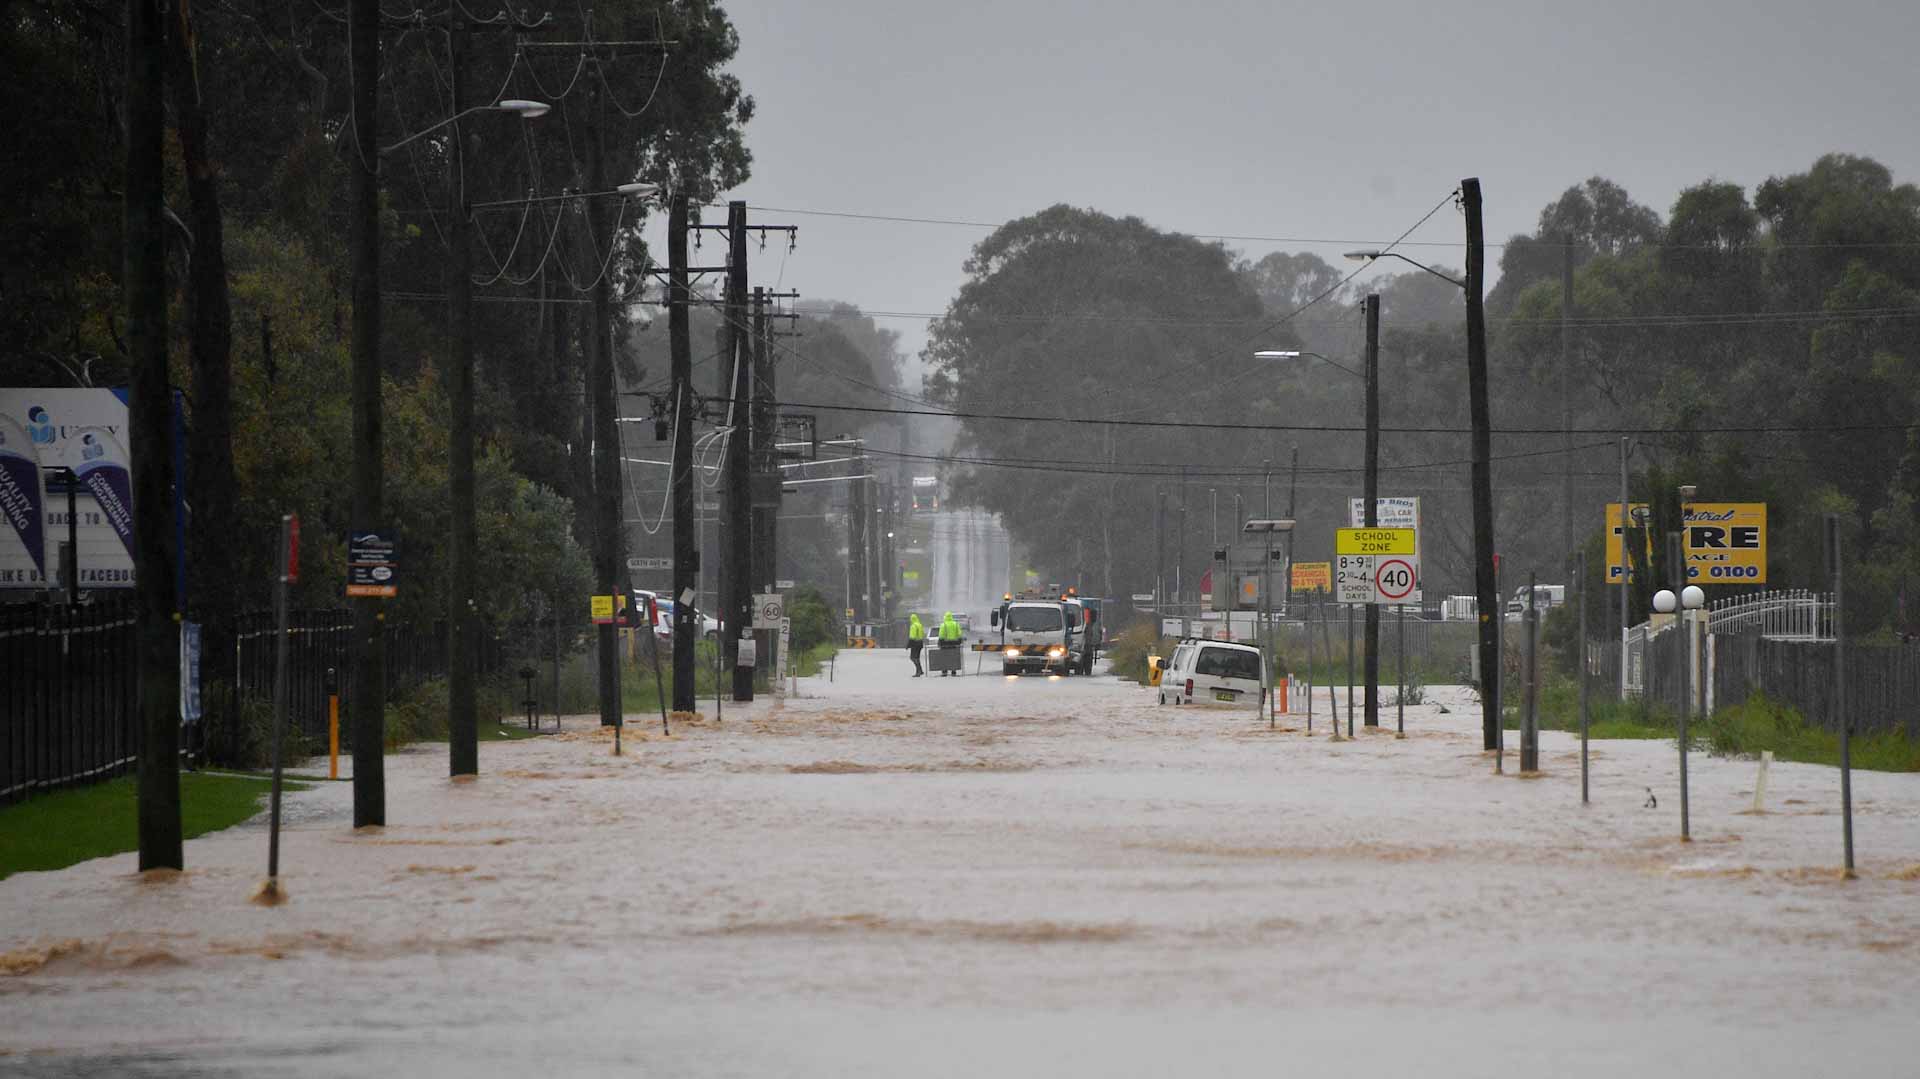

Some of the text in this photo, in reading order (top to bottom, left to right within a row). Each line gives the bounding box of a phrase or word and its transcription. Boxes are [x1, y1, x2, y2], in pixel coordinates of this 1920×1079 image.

[93, 472, 131, 524] COMMUNITY
[87, 479, 130, 537] ENGAGEMENT
[1354, 532, 1398, 541] SCHOOL
[1361, 543, 1391, 551] ZONE
[1710, 566, 1758, 577] 0100
[1383, 571, 1408, 587] 40
[1341, 584, 1372, 592] SCHOOL
[767, 607, 778, 616] 60
